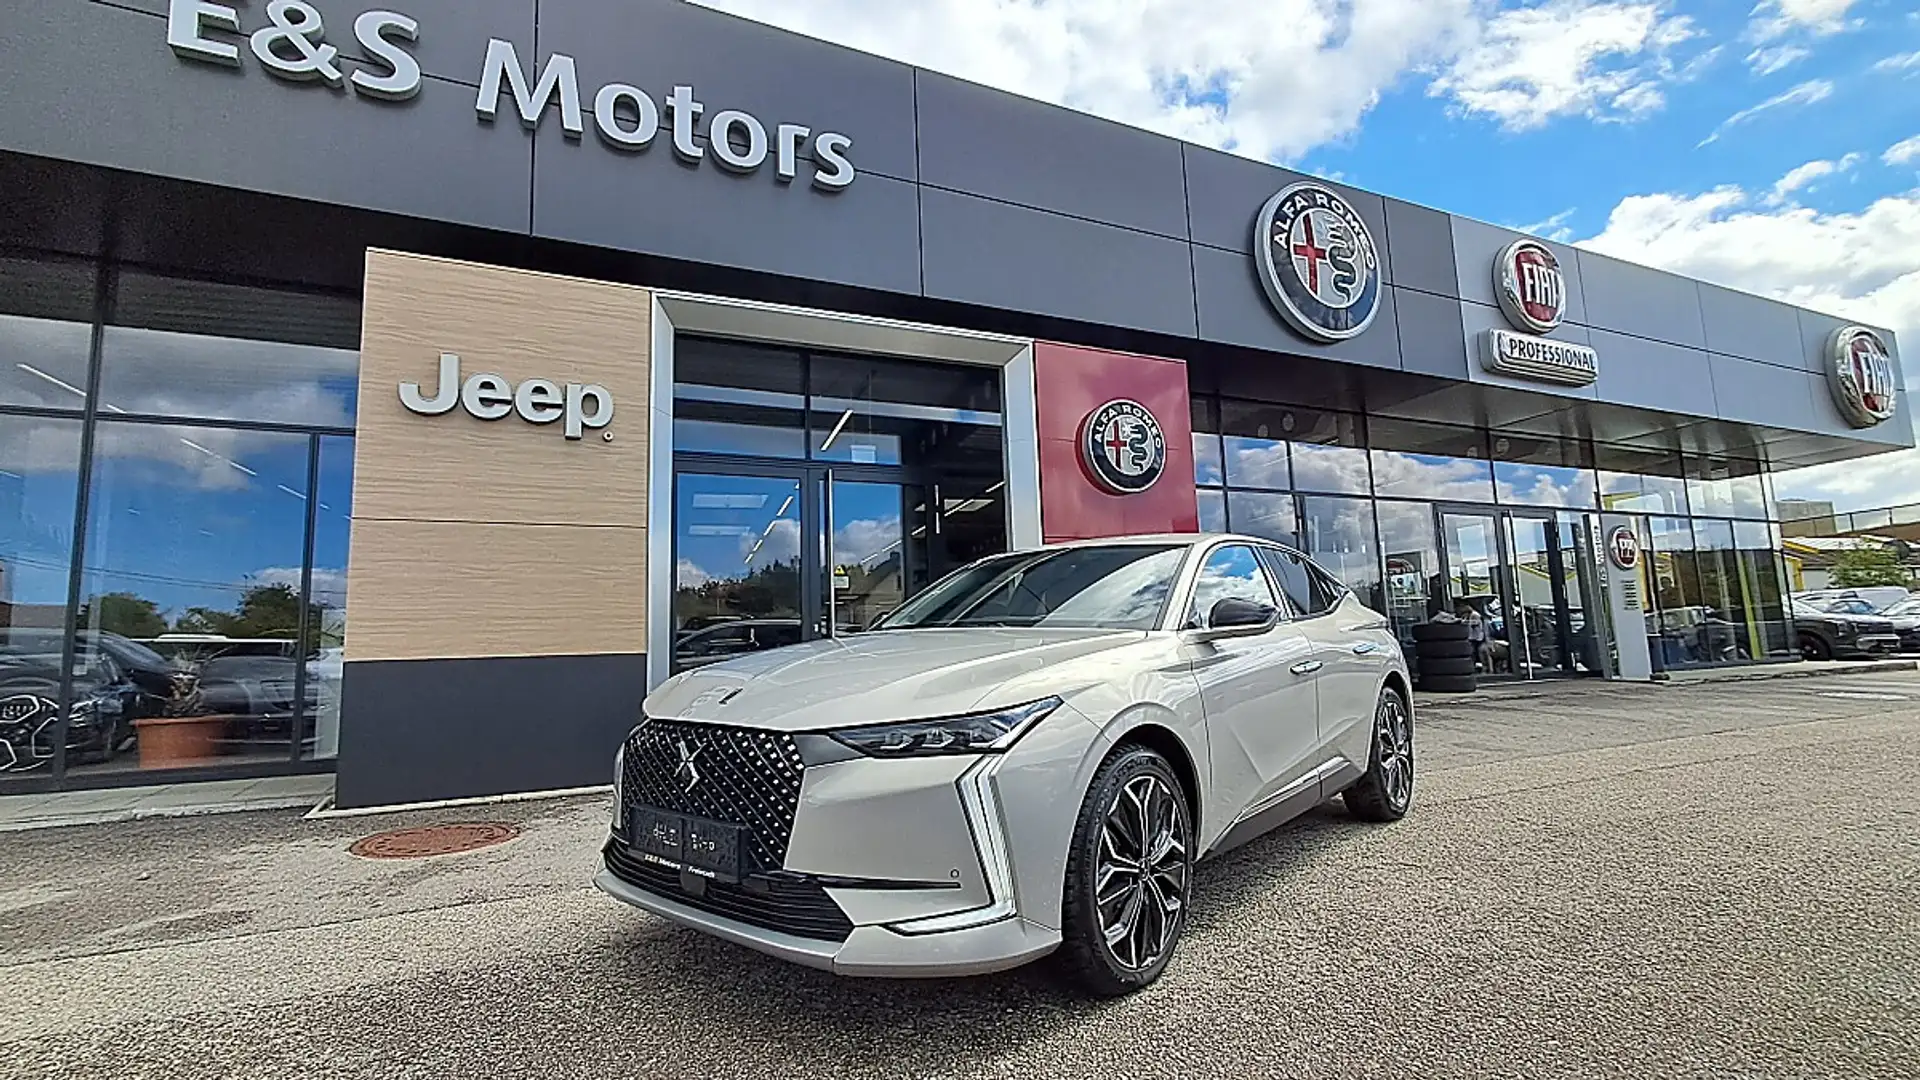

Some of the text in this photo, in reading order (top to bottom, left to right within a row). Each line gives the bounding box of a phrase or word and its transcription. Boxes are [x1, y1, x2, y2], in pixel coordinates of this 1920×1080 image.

[167, 0, 856, 191] E&S Motors
[1273, 193, 1376, 270] ALFA ROMEO
[1522, 262, 1561, 308] FIAT
[1509, 338, 1597, 371] PROFESSIONAL
[398, 352, 615, 440] Jeep
[1094, 405, 1161, 448] ALFA ROMEO
